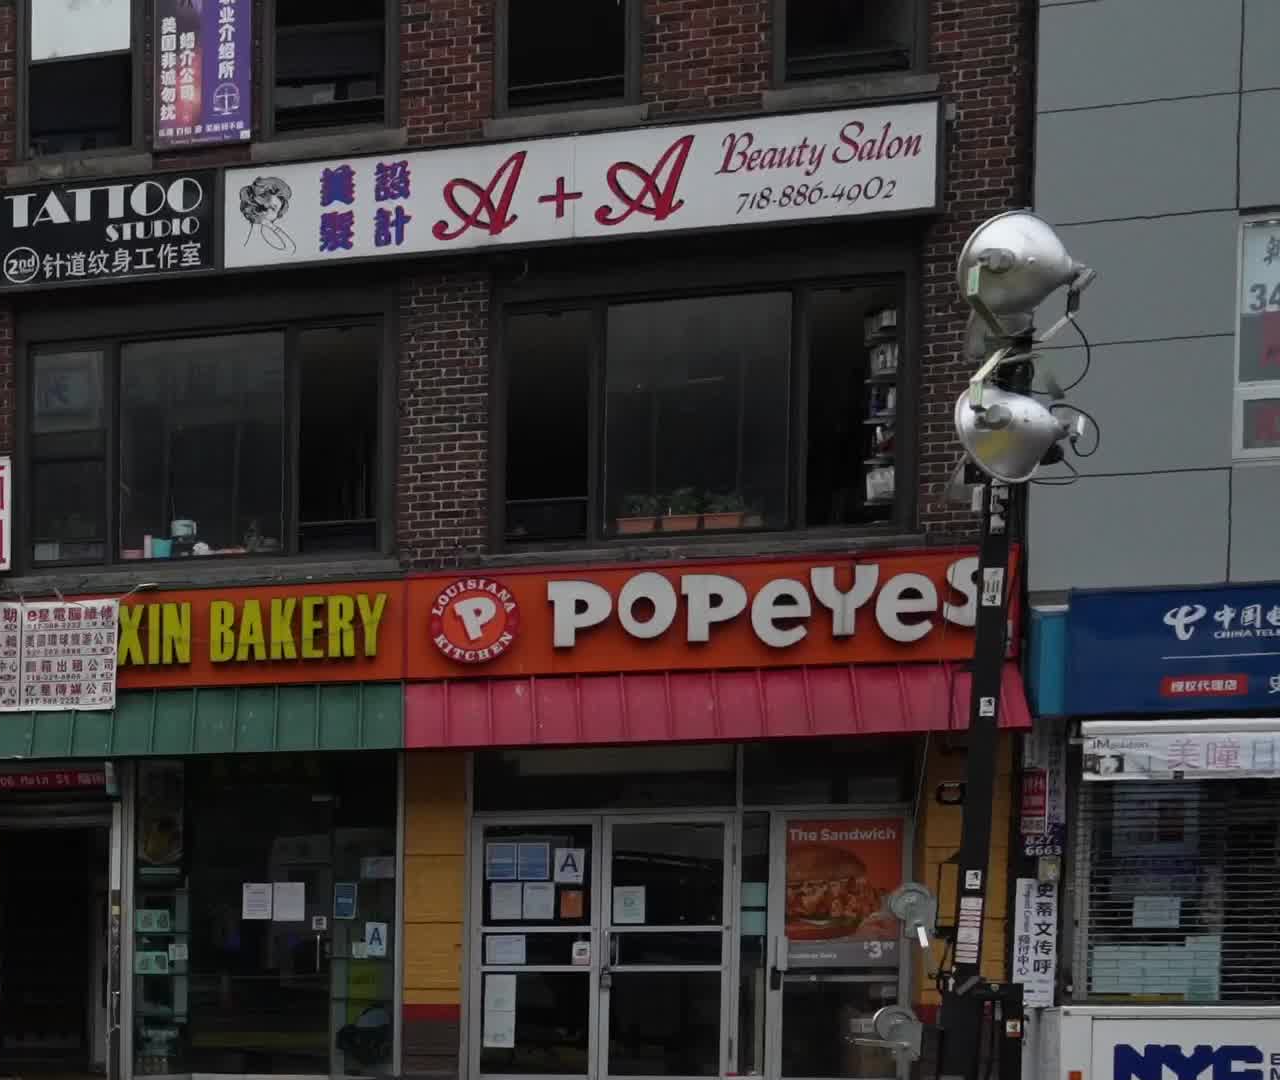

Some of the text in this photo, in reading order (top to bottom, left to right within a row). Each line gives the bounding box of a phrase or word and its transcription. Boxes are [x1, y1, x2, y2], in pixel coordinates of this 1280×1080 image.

[714, 121, 922, 178] Beauty Salon
[4, 177, 202, 228] TATTOO
[736, 176, 897, 215] 718-886-4902
[106, 217, 199, 243] STUDIO
[42, 240, 202, 278] 针道纹身工作室
[431, 578, 516, 617] LOUISIANA
[210, 594, 387, 663] BAKERY
[1214, 628, 1252, 640] CHINA
[433, 634, 513, 664] KITCHEN
[790, 827, 896, 841] The Sandwich
[560, 853, 578, 872] A
